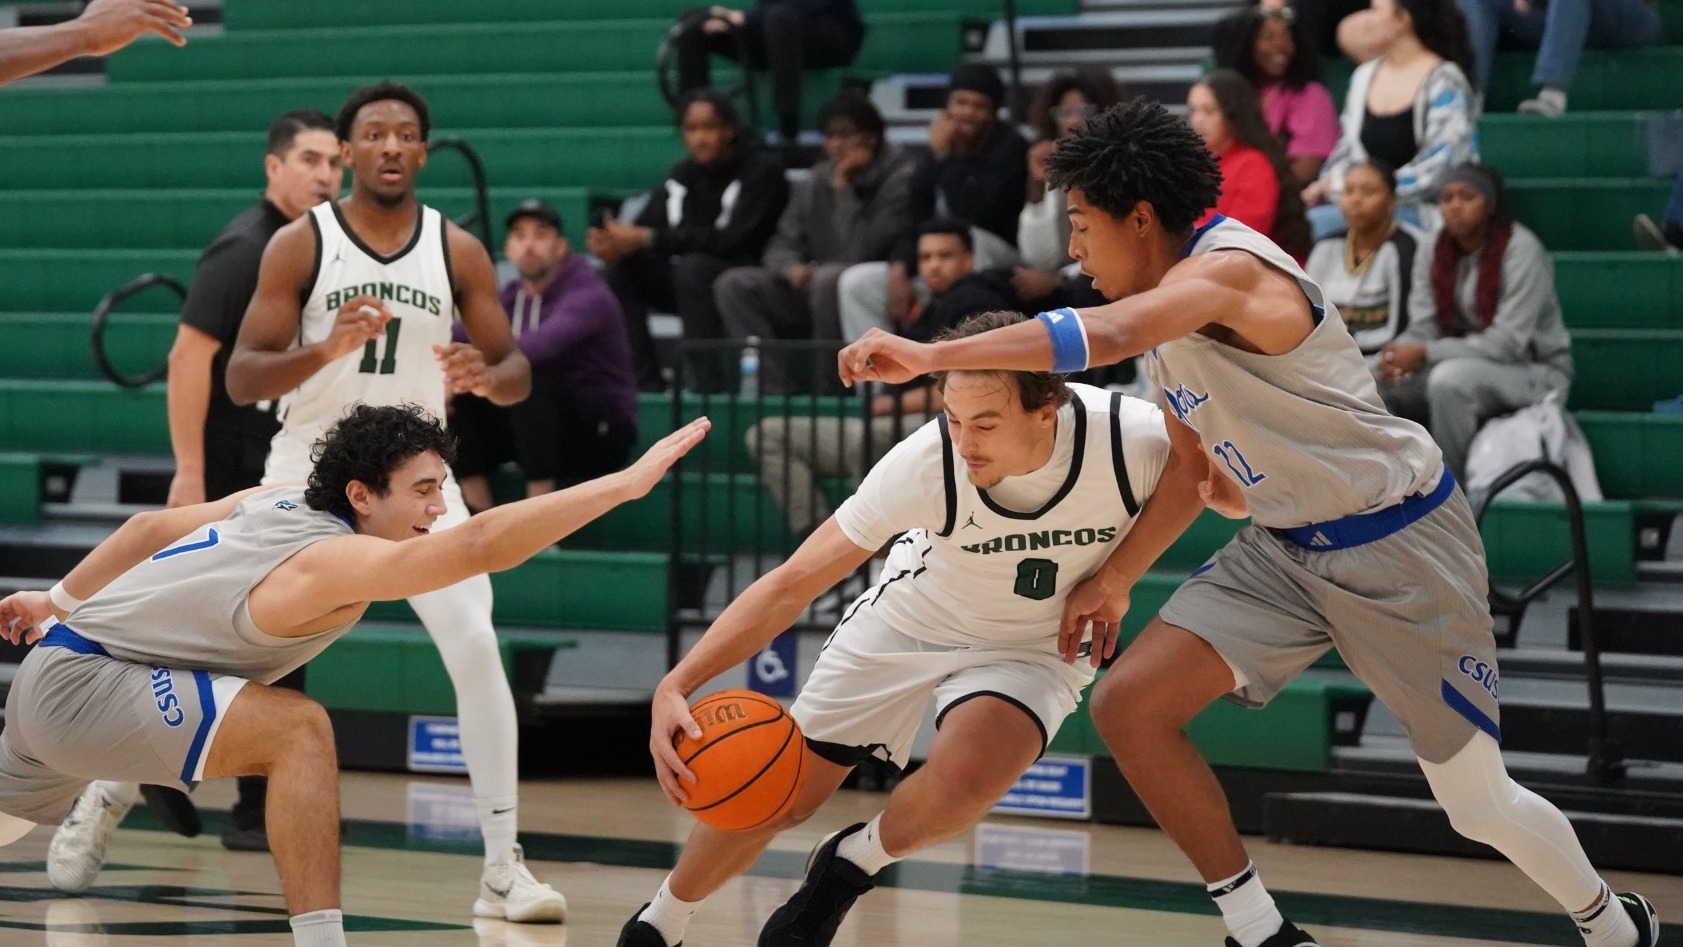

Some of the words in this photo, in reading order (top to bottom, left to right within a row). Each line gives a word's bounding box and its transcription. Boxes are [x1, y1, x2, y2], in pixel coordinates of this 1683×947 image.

[325, 281, 441, 316] BRONCOS
[358, 317, 402, 374] 11
[1213, 440, 1266, 487] 12
[1014, 557, 1059, 600] 0
[151, 664, 185, 729] CSUS
